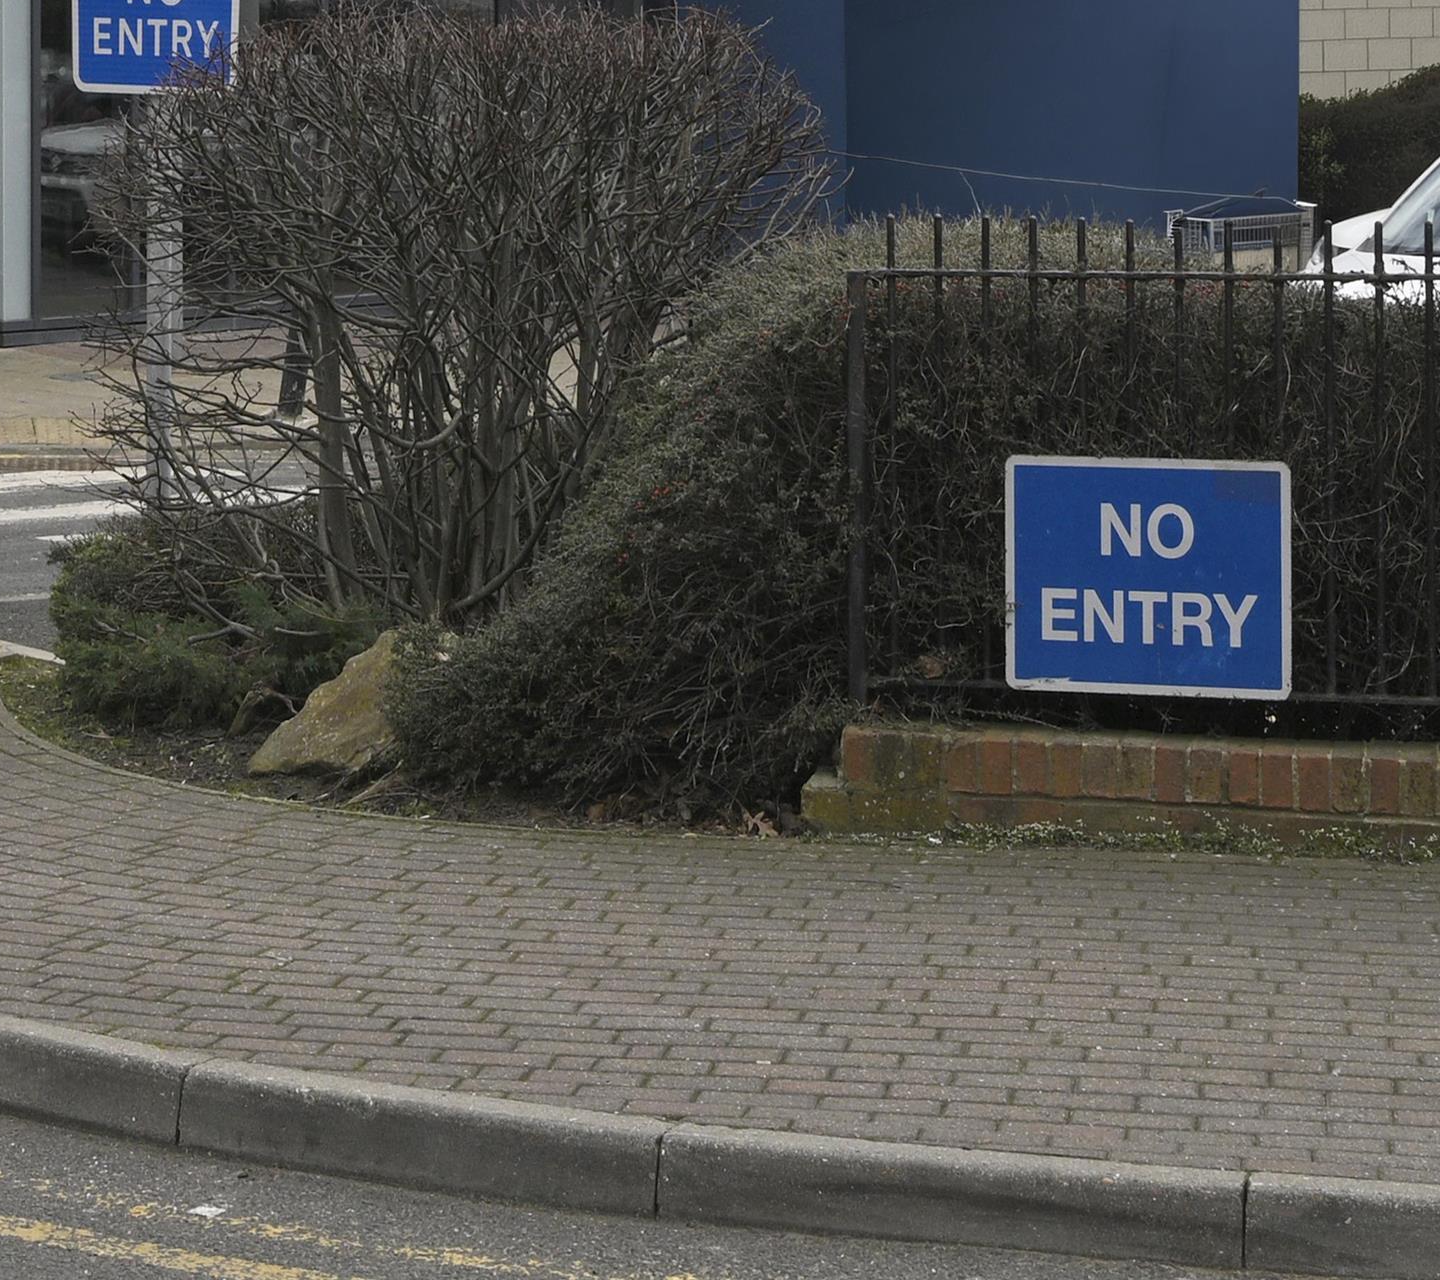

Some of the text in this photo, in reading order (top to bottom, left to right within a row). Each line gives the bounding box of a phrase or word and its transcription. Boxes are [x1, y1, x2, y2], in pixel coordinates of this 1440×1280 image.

[93, 17, 219, 58] ENTRY
[1100, 502, 1195, 560] NO
[1041, 587, 1258, 648] ENTRY
